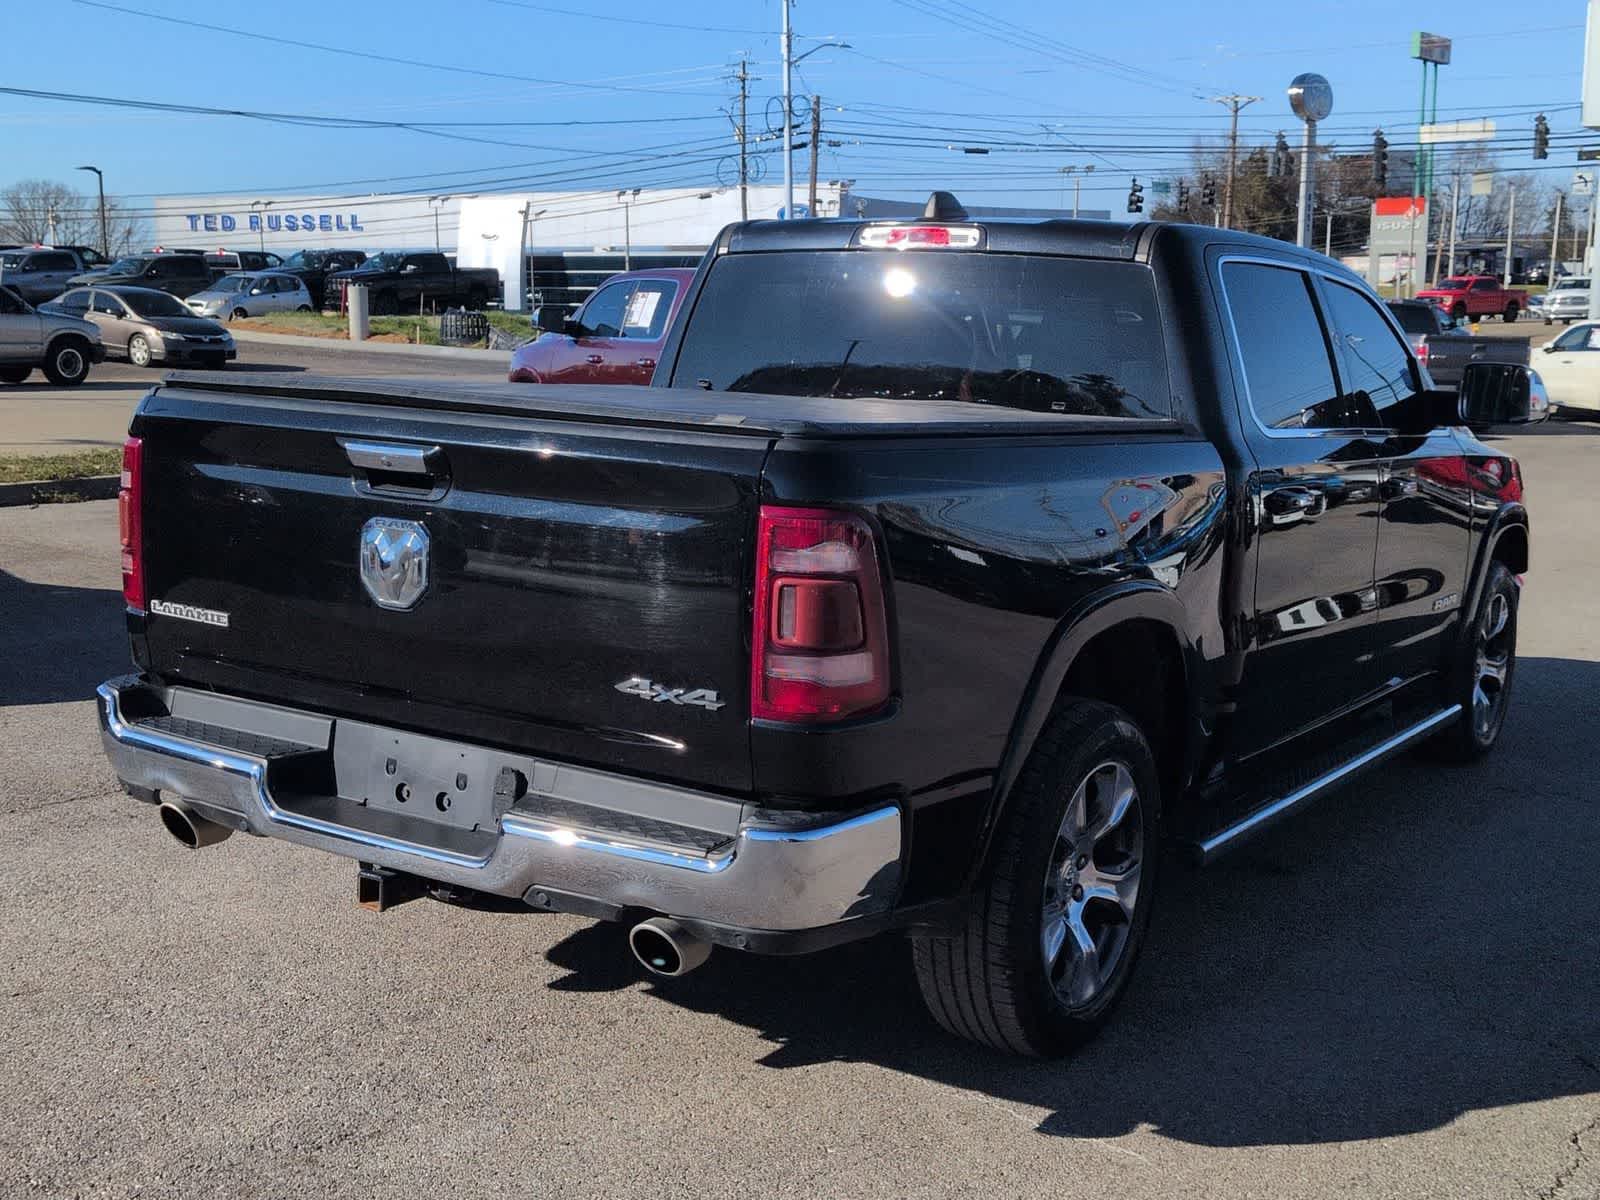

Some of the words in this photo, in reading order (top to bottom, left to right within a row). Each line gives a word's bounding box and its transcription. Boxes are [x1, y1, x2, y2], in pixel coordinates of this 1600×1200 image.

[186, 214, 236, 231] TED
[249, 214, 363, 231] RUSSELL
[150, 599, 229, 627] LARAMIE
